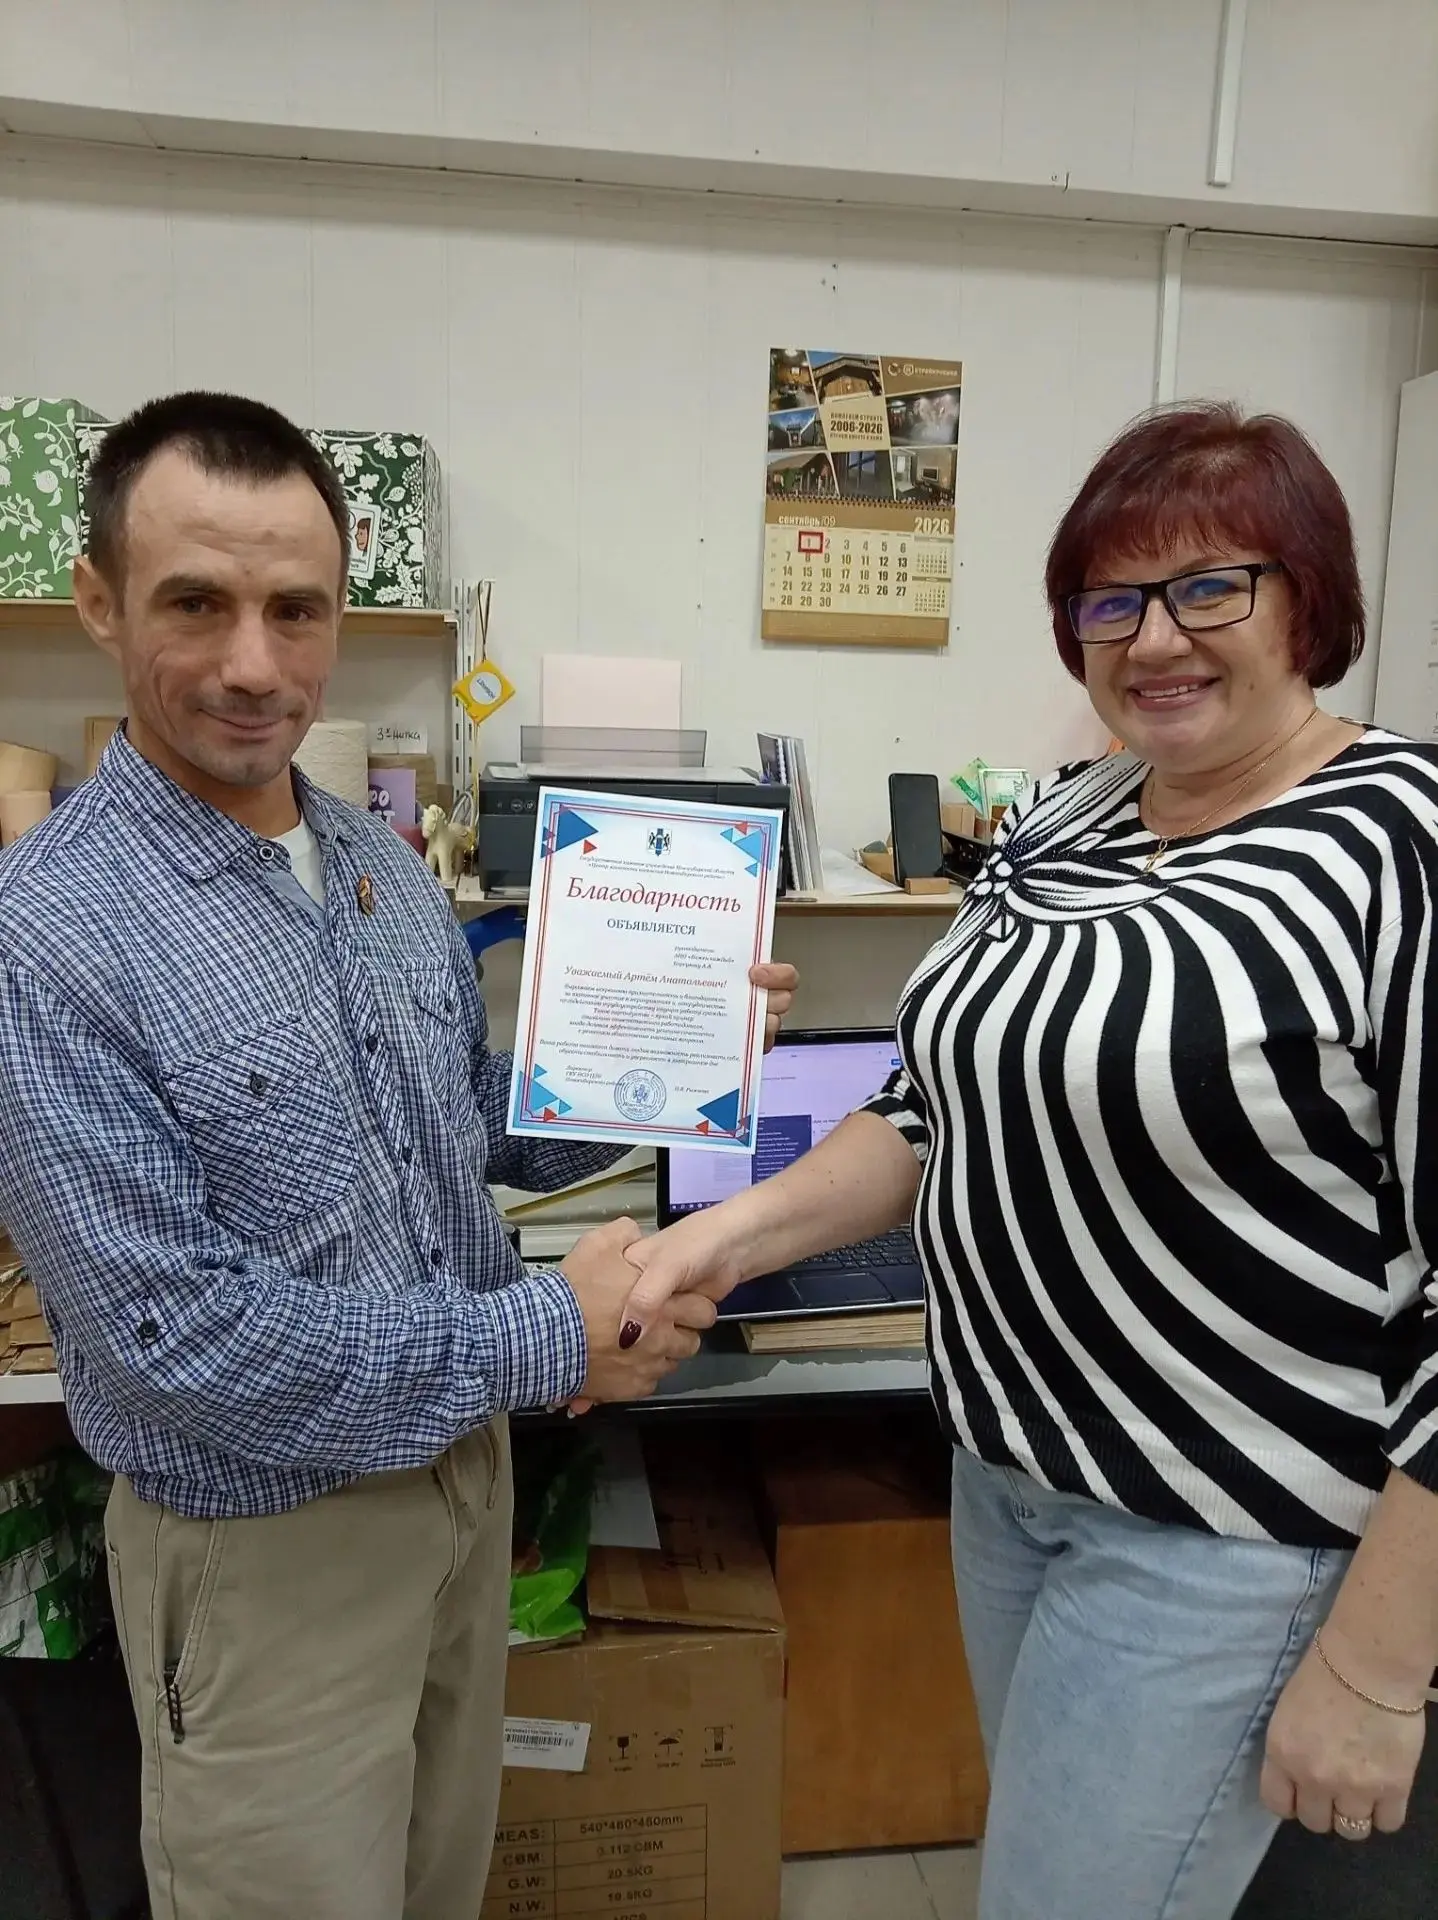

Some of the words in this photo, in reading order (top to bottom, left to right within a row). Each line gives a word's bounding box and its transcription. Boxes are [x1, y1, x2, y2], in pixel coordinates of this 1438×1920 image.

[914, 516, 950, 535] 2026
[842, 554, 851, 565] 10
[861, 555, 869, 566] 11
[879, 556, 889, 567] 12
[898, 557, 908, 568] 13
[783, 565, 792, 576] 14
[803, 566, 813, 577] 15
[822, 567, 832, 578] 16
[842, 568, 850, 579] 17
[860, 569, 869, 581] 18
[878, 570, 888, 581] 19
[896, 571, 908, 582] 20
[782, 580, 792, 591] 21
[801, 581, 812, 592] 22
[820, 582, 832, 593] 23
[840, 583, 850, 594] 24
[858, 584, 869, 595] 25
[876, 585, 888, 596] 26
[896, 586, 906, 597] 27
[781, 595, 792, 606] 28
[819, 597, 832, 608] 30
[566, 876, 742, 913] Благодарность
[607, 918, 696, 936] ОБЪЯВЛЯЕТСЯ
[564, 965, 623, 979] Уважаемый
[624, 970, 658, 983] Артём
[659, 975, 728, 988] Анатольевич!
[493, 1828, 545, 1843] MEAS:
[502, 1852, 545, 1867] CBM:
